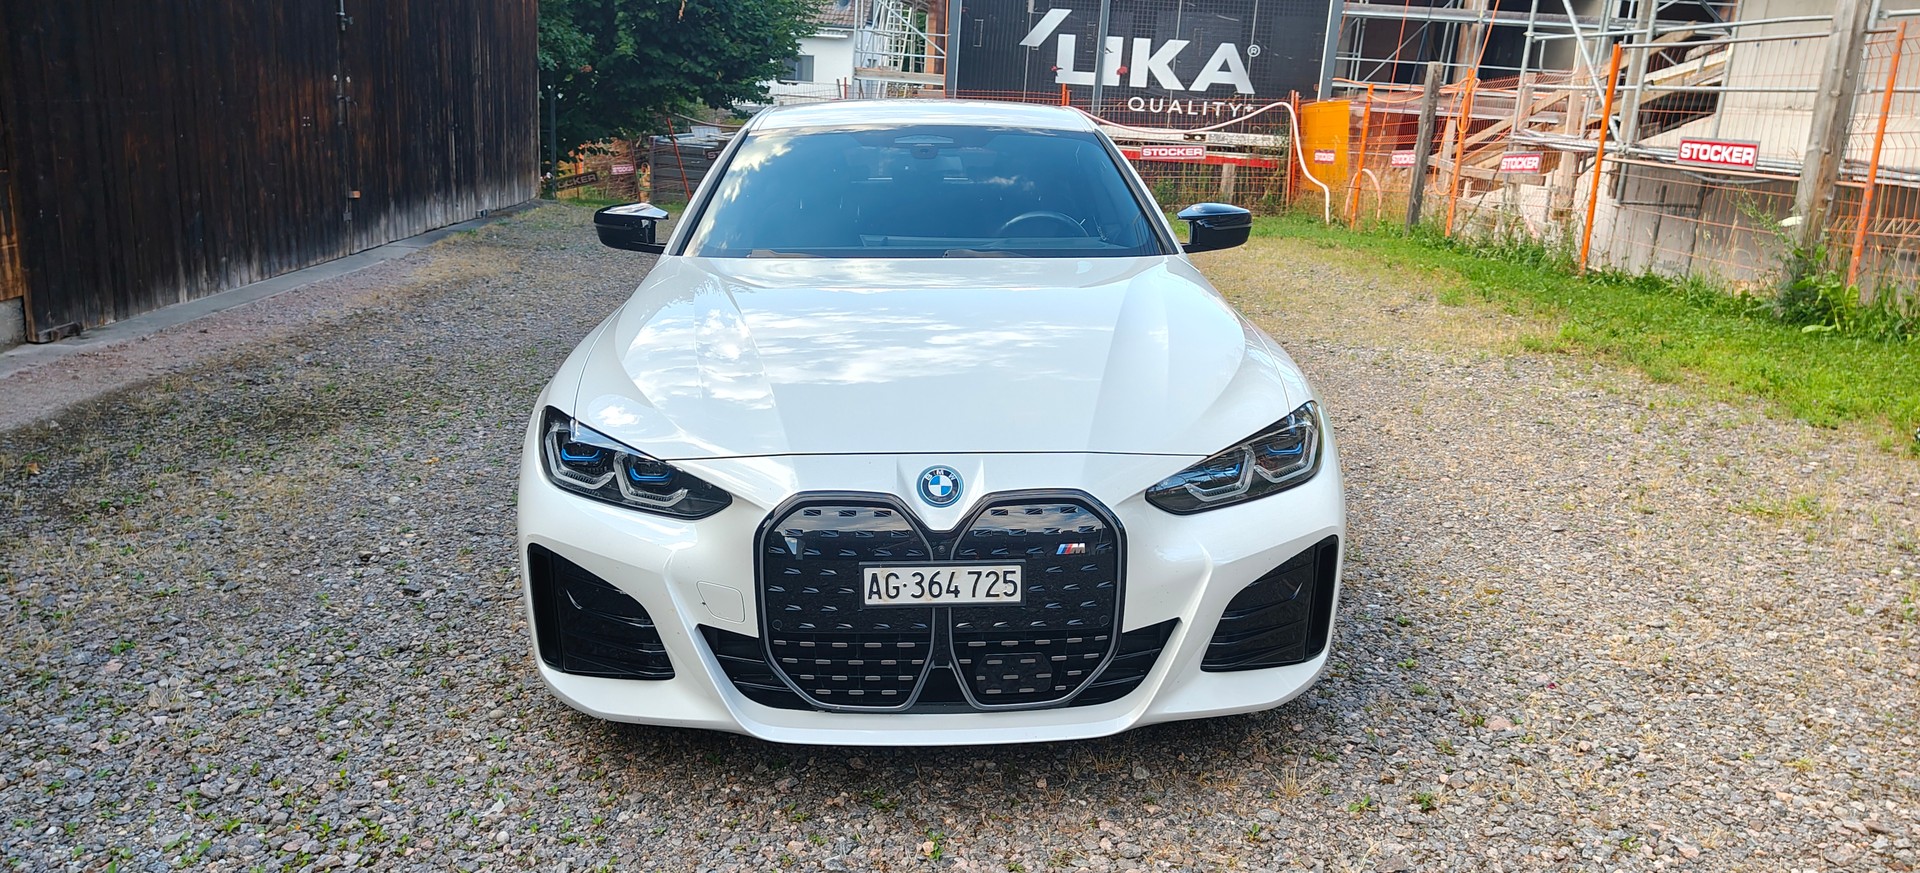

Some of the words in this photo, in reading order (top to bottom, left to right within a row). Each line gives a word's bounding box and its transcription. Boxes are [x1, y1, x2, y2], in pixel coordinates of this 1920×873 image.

[1142, 148, 1203, 157] STOCKER
[1682, 142, 1756, 164] STOCKER
[1501, 157, 1540, 169] STOCKER
[967, 570, 1018, 598] 725
